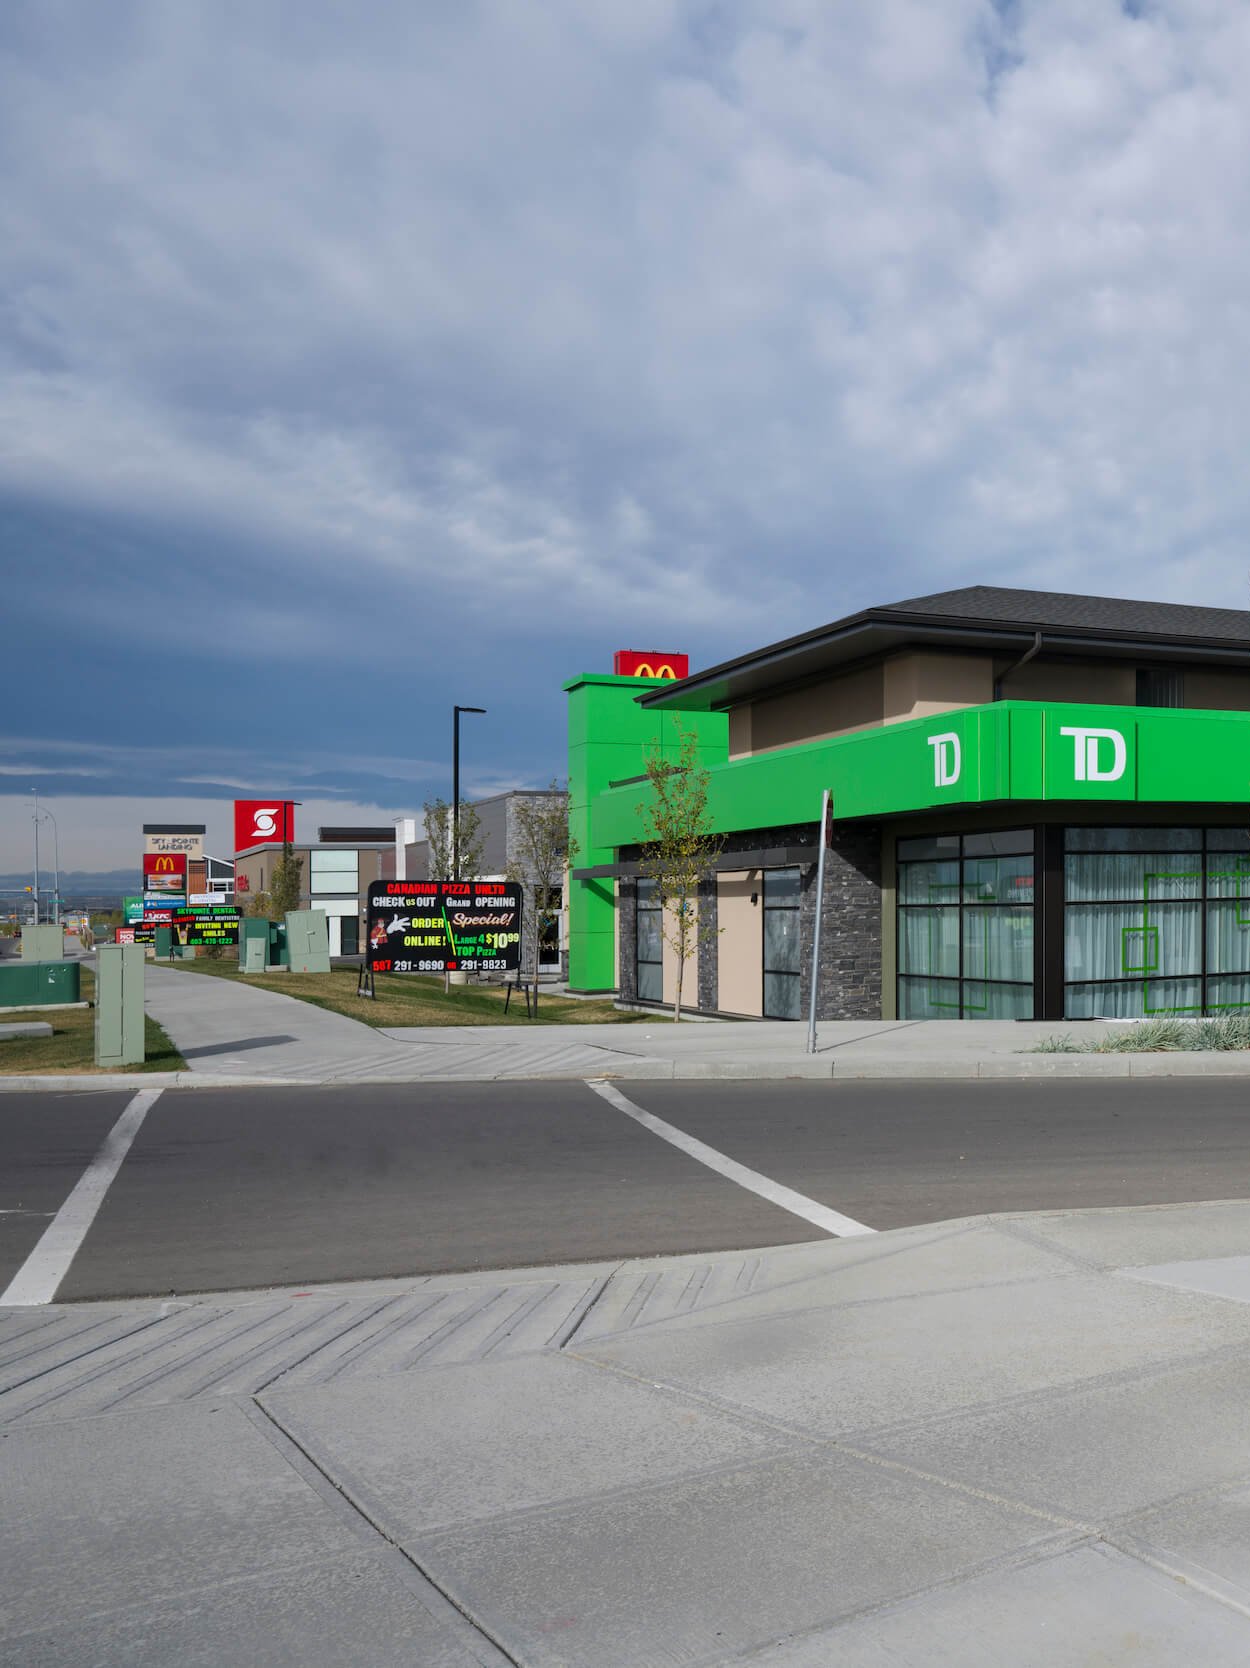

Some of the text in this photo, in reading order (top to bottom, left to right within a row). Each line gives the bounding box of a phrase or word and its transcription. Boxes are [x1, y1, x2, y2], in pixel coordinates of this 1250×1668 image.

[1060, 726, 1127, 781] TD
[928, 732, 961, 787] TD
[387, 884, 505, 895] CANADIAN PIZZA UNLTD
[372, 896, 405, 907] CHECK
[416, 896, 436, 907] OUT
[475, 897, 516, 907] OPENING
[411, 917, 444, 928] ORDER
[453, 912, 514, 928] Special!
[478, 934, 485, 944] 4
[456, 946, 475, 956] TOP
[373, 960, 392, 971] 587
[394, 960, 445, 971] 291-9690
[460, 959, 507, 970] 291-9823
